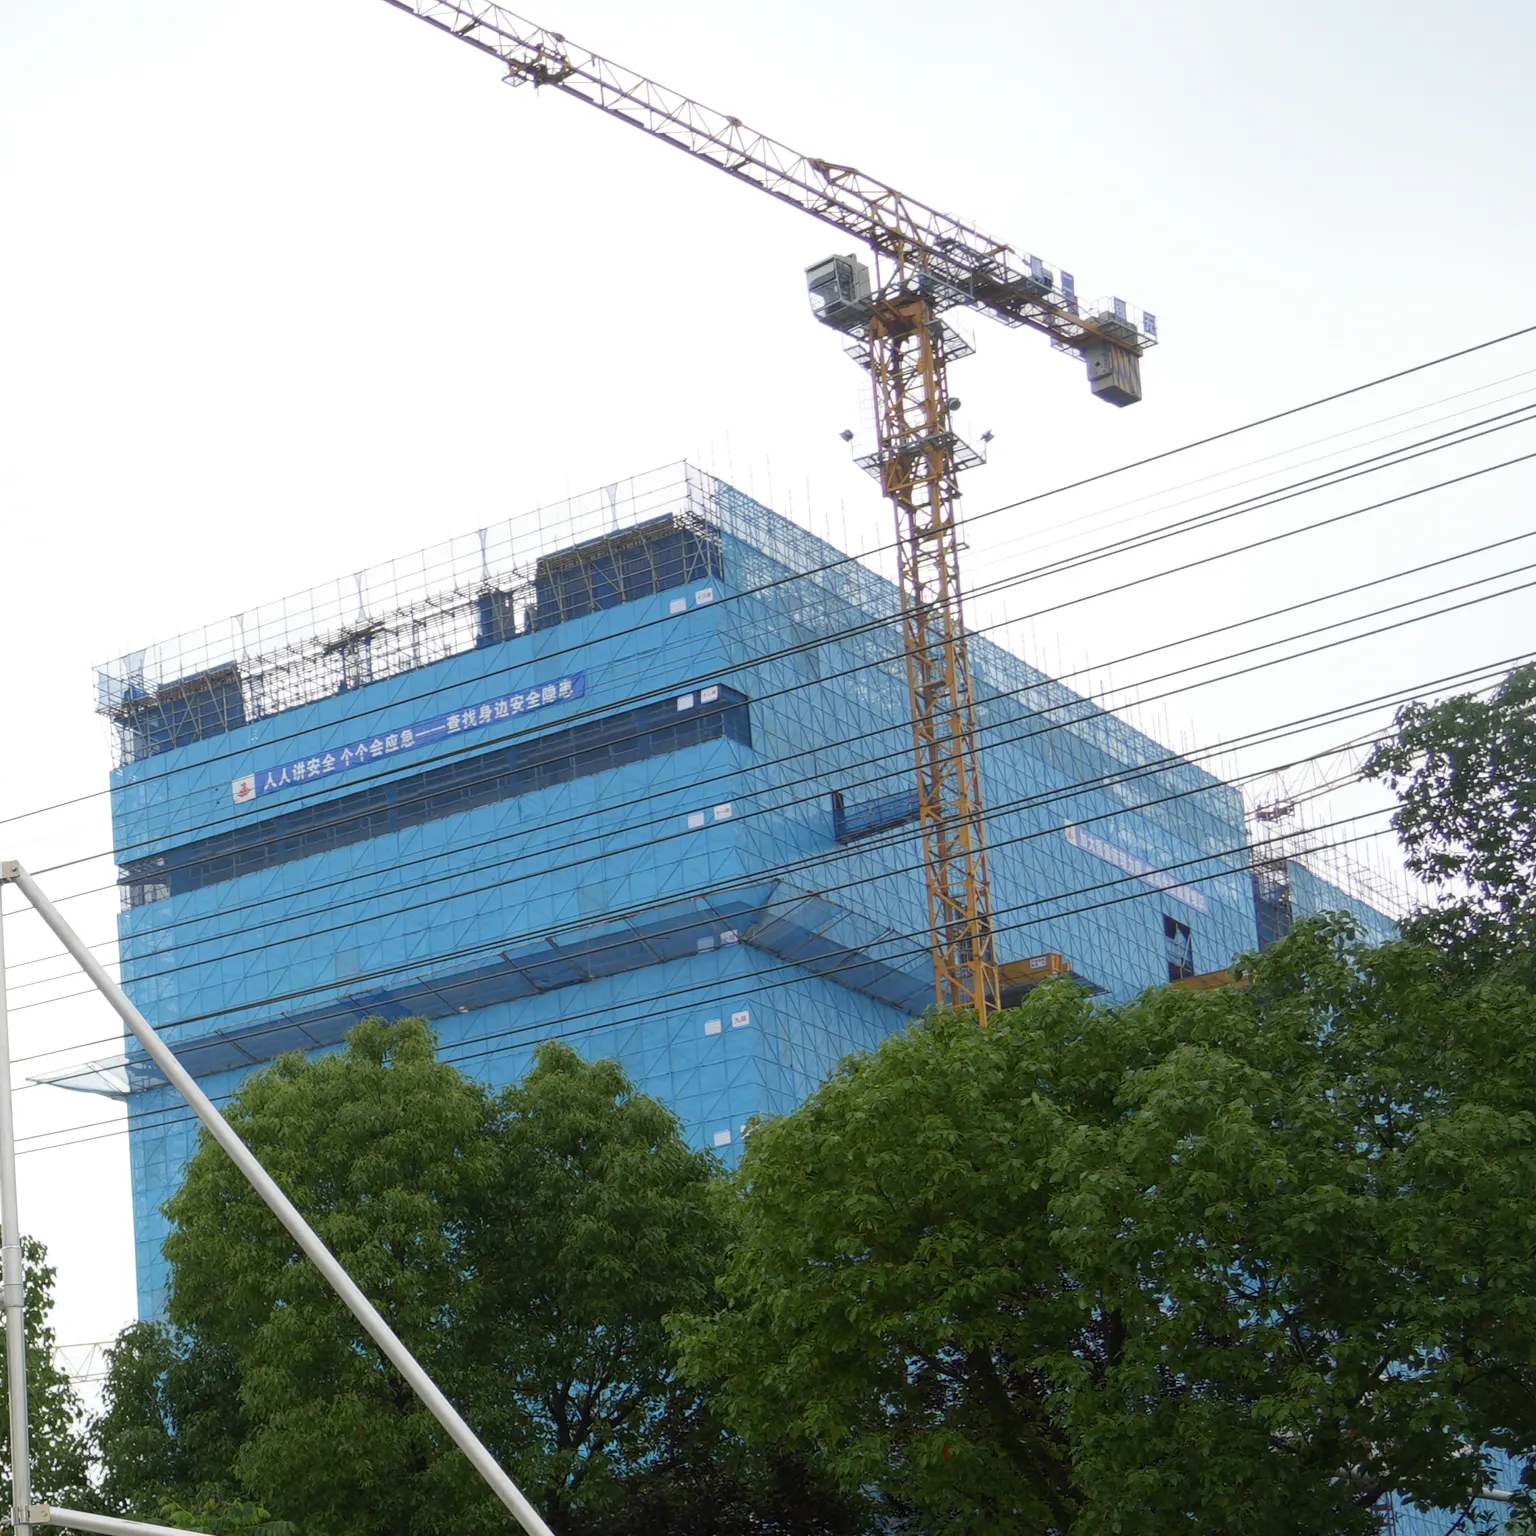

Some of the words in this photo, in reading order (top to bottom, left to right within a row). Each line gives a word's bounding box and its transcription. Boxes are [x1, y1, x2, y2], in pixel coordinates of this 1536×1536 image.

[263, 753, 336, 791] 人人讲安全
